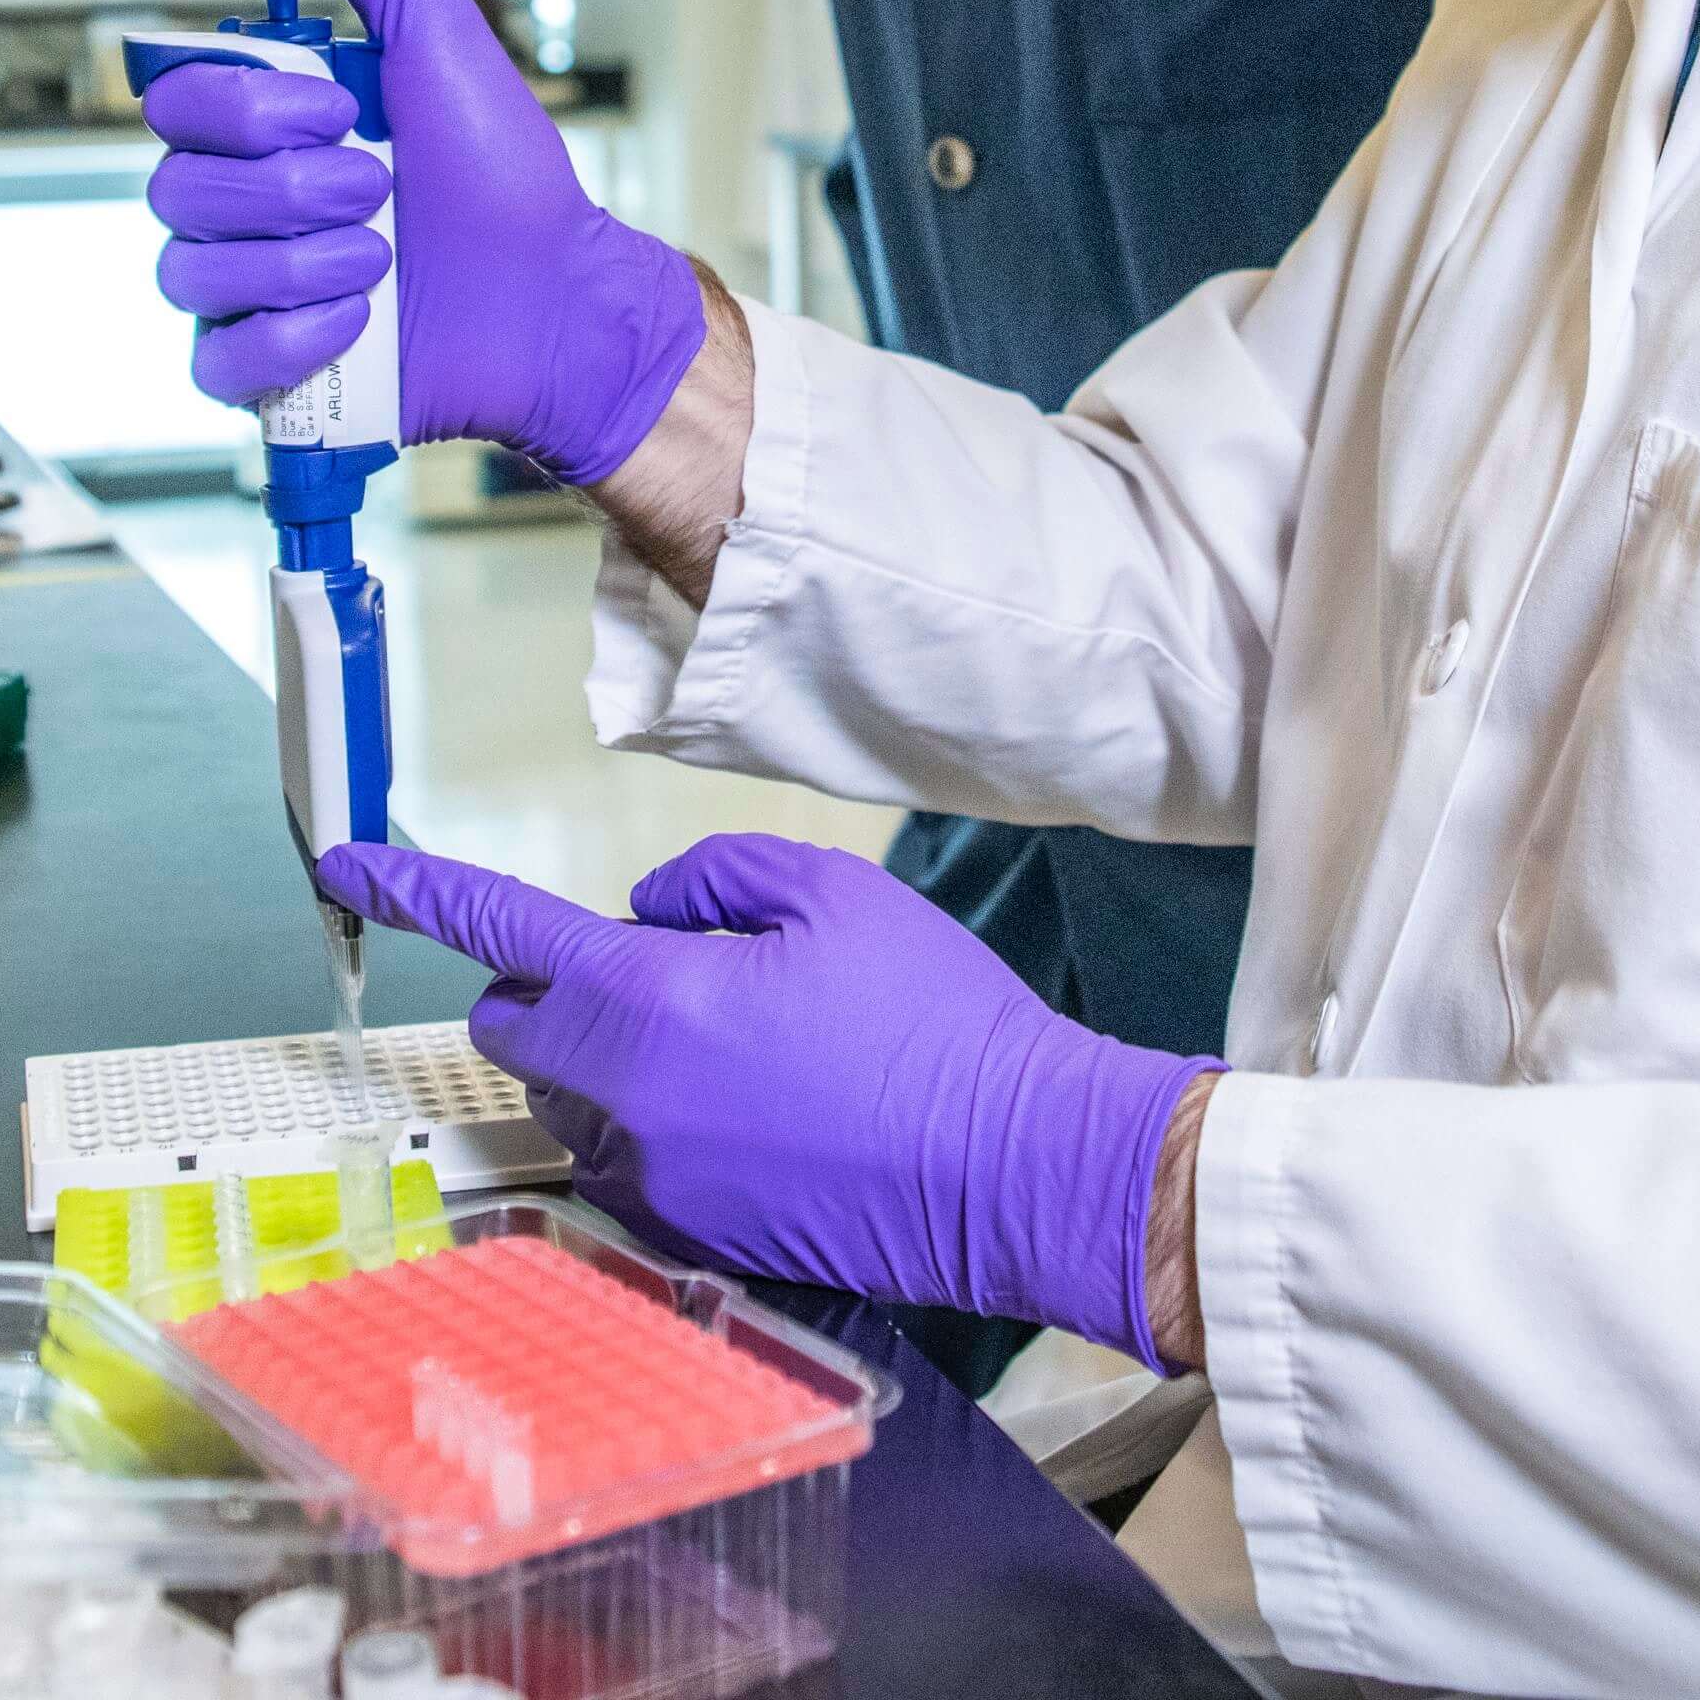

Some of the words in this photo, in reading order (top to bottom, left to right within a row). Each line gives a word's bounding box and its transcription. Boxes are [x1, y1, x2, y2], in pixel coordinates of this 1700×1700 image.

[328, 363, 341, 421] ARLOW
[288, 420, 296, 437] Due
[298, 426, 306, 437] By
[307, 423, 315, 437] Cal
